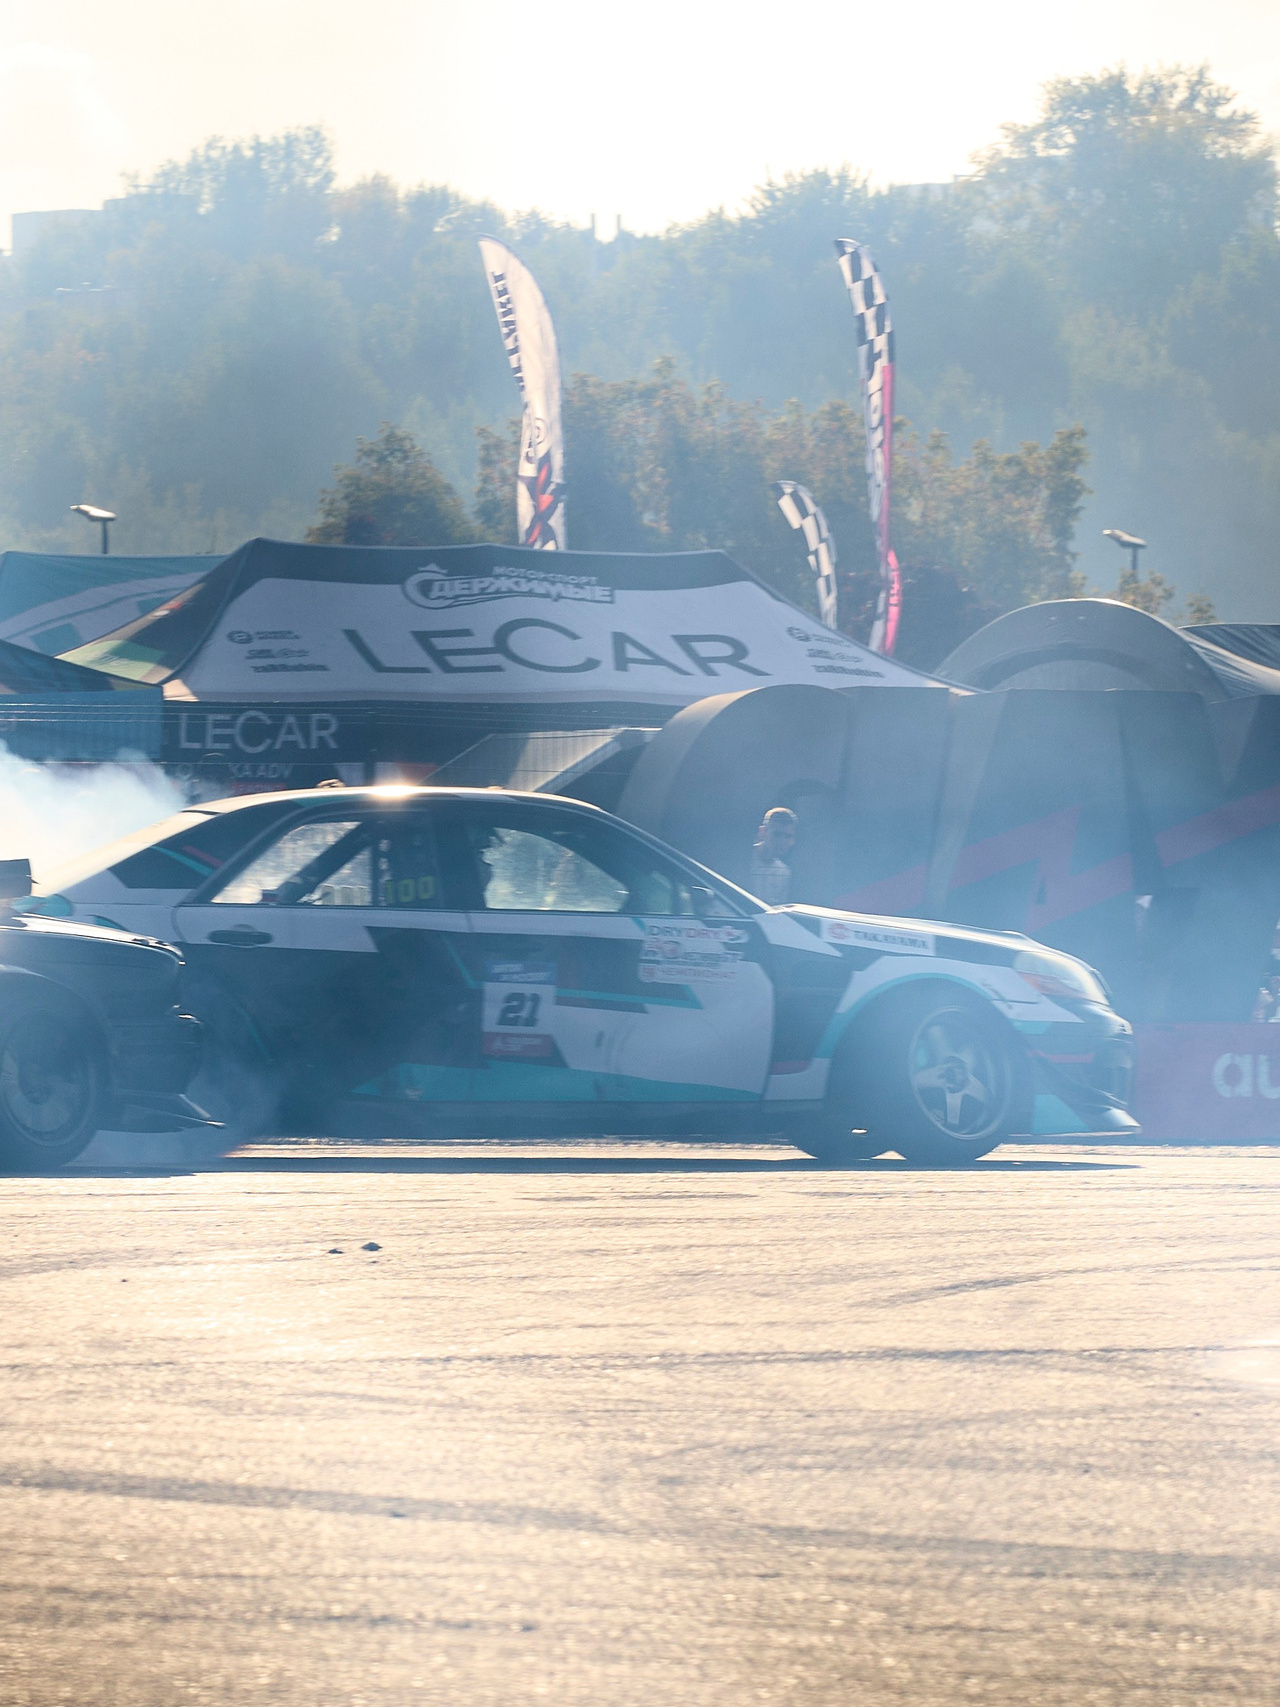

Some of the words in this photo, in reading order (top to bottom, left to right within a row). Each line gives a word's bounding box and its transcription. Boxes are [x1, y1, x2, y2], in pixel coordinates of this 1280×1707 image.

[343, 617, 773, 676] LECAR
[178, 710, 339, 753] LECAR
[496, 992, 542, 1028] 21
